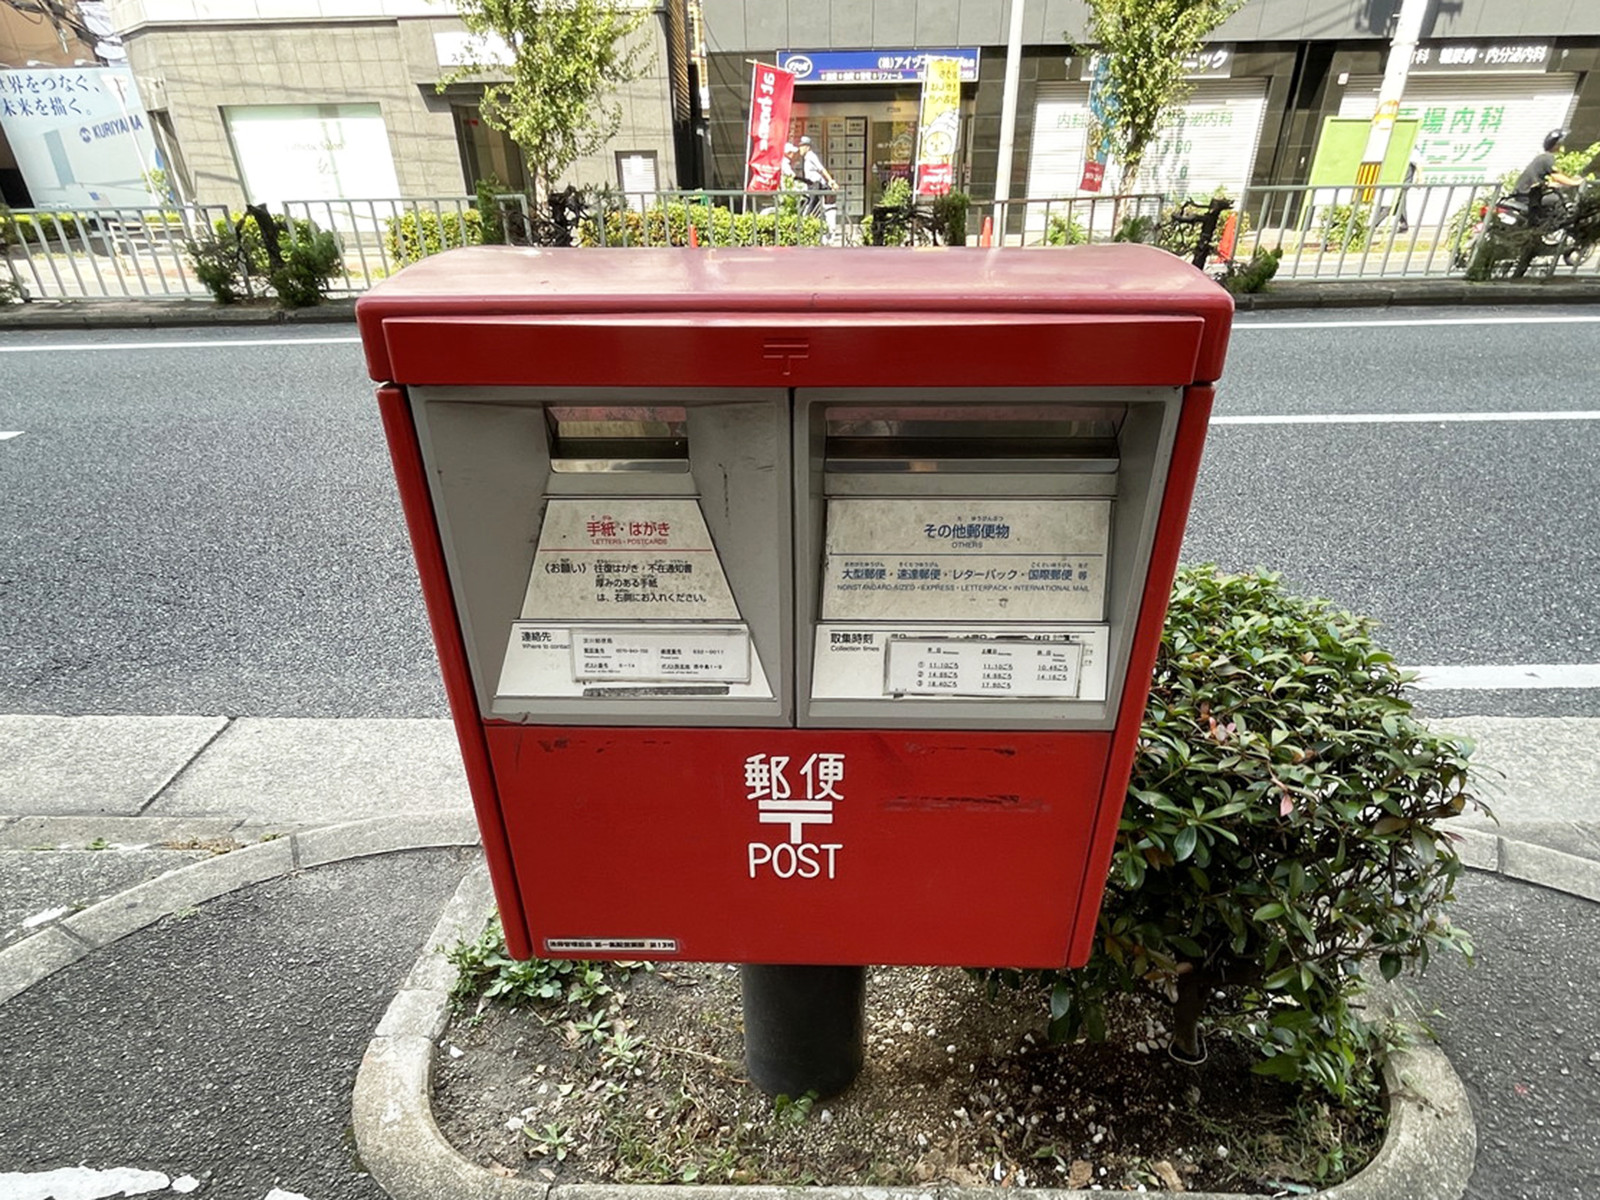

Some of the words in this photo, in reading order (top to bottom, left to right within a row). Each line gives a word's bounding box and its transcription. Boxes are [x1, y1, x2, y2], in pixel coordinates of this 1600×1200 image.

[923, 523, 1010, 539] その他郵便物
[951, 541, 984, 549] OTHERS
[830, 633, 874, 644] 取集時刻
[744, 753, 846, 800] 郵便
[748, 842, 844, 879] POST
